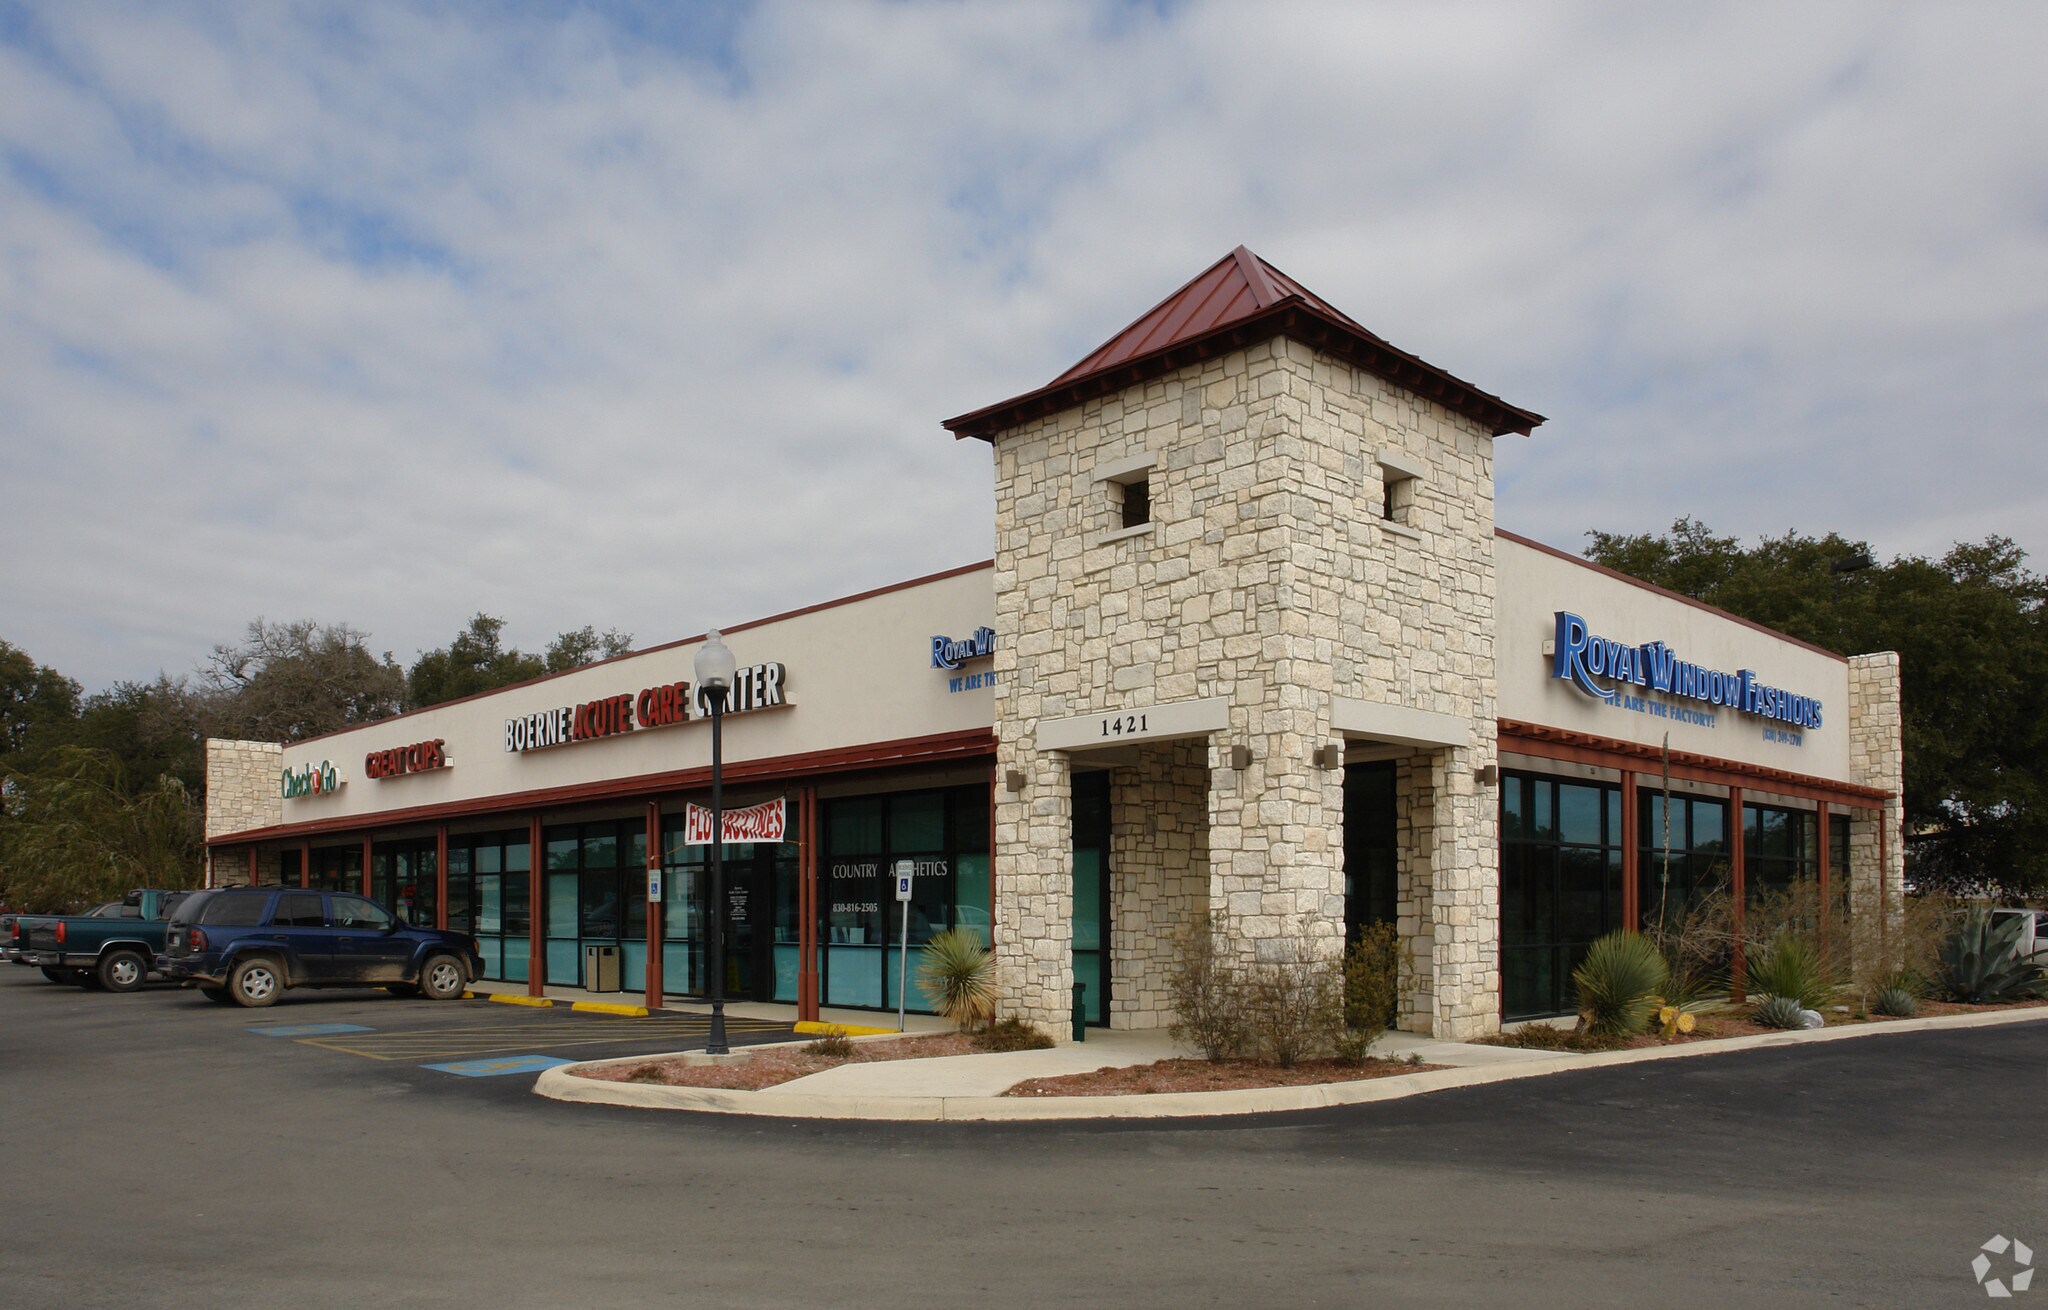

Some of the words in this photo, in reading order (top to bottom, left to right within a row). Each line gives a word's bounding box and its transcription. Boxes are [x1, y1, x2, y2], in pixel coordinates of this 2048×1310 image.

[930, 635, 973, 670] ROYAL
[1553, 611, 1646, 698] ROYAL
[1644, 641, 1742, 708] WINDOW
[1741, 669, 1823, 729] FASHIONS
[949, 678, 963, 693] WE
[965, 674, 982, 691] ARE
[984, 672, 997, 687] TH
[505, 707, 570, 752] BOERNE
[573, 694, 632, 740] ACUTE
[637, 681, 688, 727] CARE
[693, 662, 785, 717] CNTER
[1101, 714, 1148, 736] 1421
[1604, 691, 1621, 707] WE
[1624, 695, 1645, 713] ARE
[1648, 700, 1667, 718] THE
[1670, 707, 1715, 728] FACTORY!
[365, 747, 406, 779] GREAT
[407, 739, 443, 773] CLIPS
[282, 763, 313, 799] Check
[320, 760, 338, 792] Go
[689, 805, 712, 841] FLU
[832, 864, 878, 879] COUNTRY
[832, 903, 878, 913] 830-816-2505
